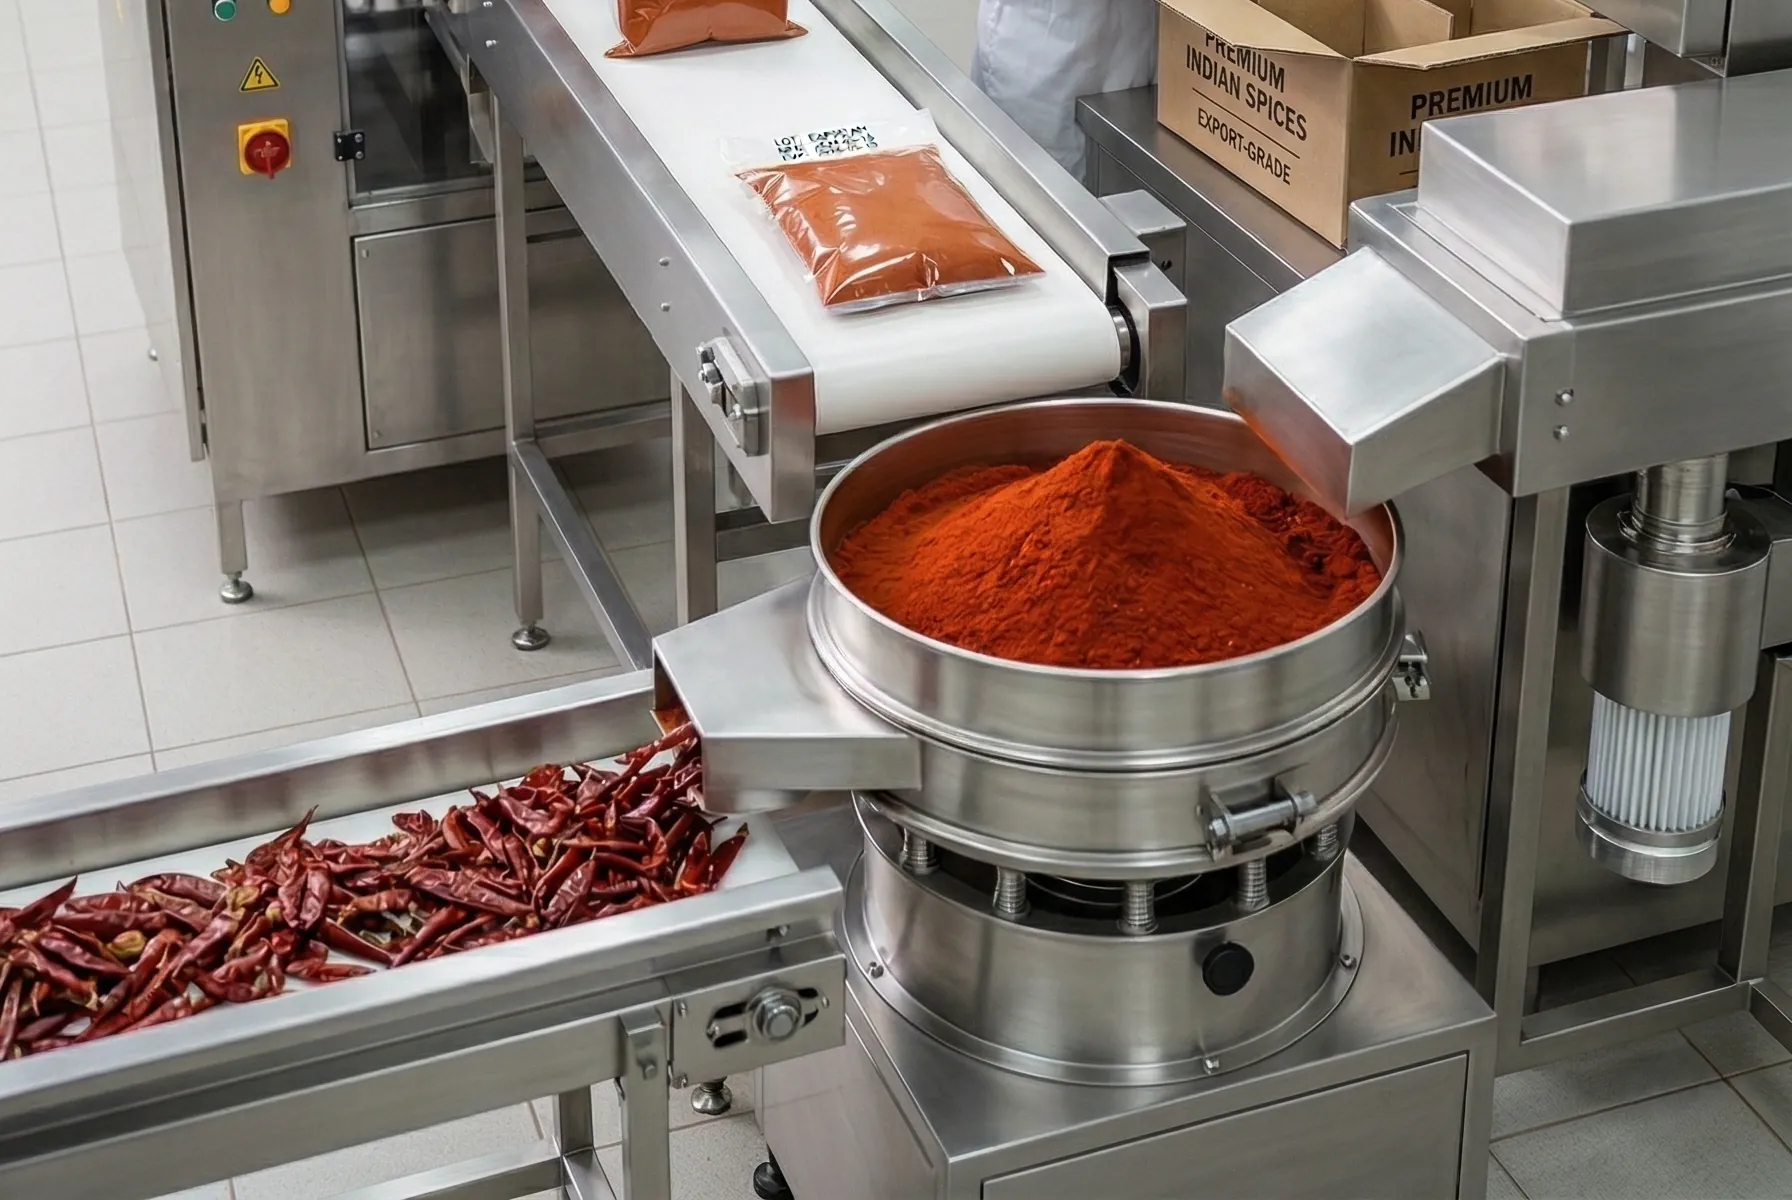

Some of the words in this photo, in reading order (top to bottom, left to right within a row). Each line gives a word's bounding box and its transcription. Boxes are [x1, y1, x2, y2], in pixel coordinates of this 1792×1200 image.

[1186, 44, 1241, 100] INDIAN
[1245, 82, 1307, 141] SPICES
[1205, 33, 1285, 93] PREMIUM
[1411, 74, 1533, 120] PREMIUM
[1198, 107, 1291, 185] EXPORT-GRADE
